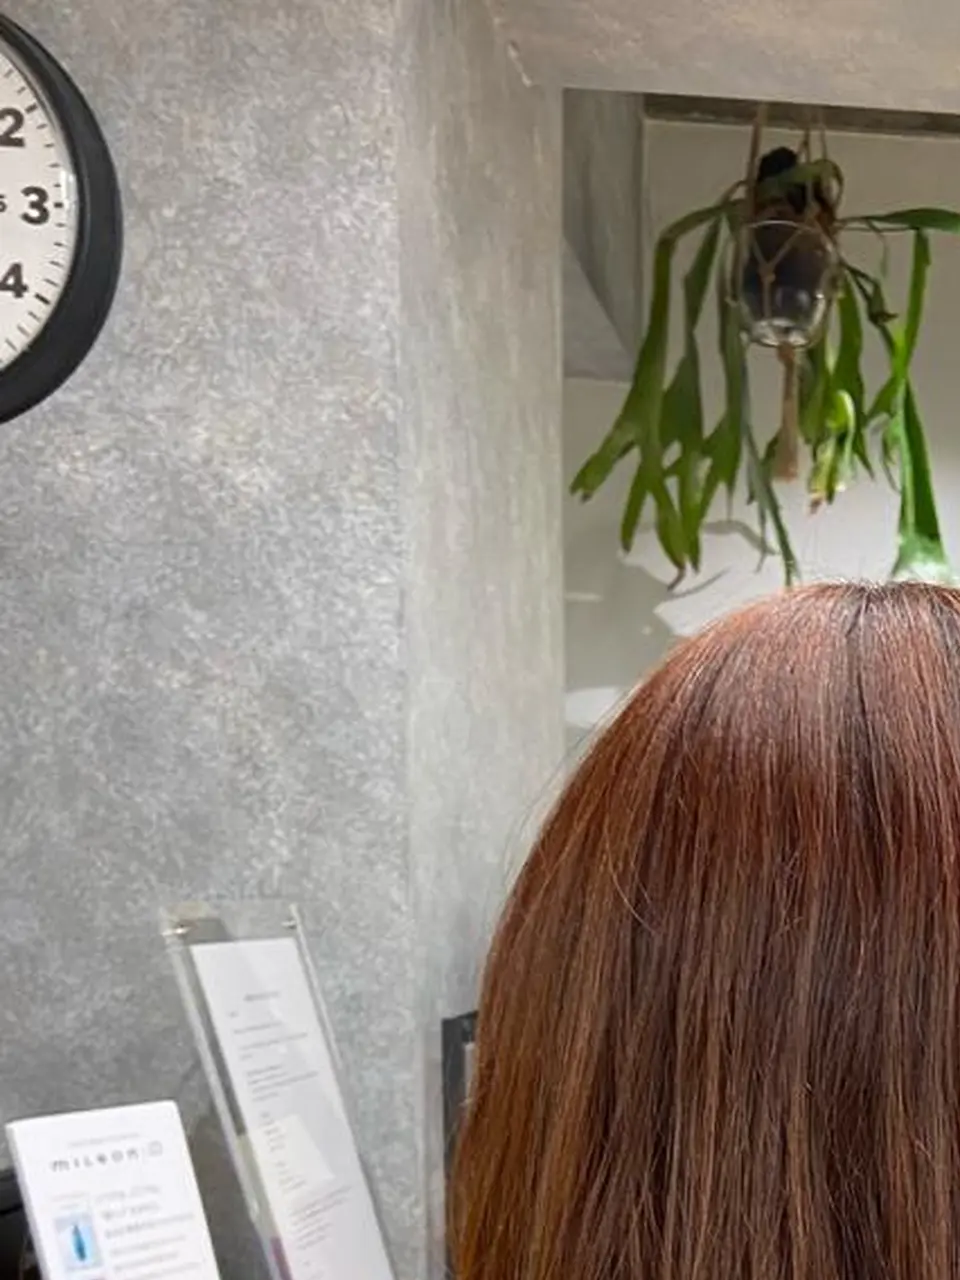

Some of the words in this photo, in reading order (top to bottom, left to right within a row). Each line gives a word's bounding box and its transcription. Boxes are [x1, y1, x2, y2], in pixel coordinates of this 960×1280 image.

[0, 107, 25, 147] 2
[20, 186, 50, 226] 3
[0, 262, 29, 299] 4
